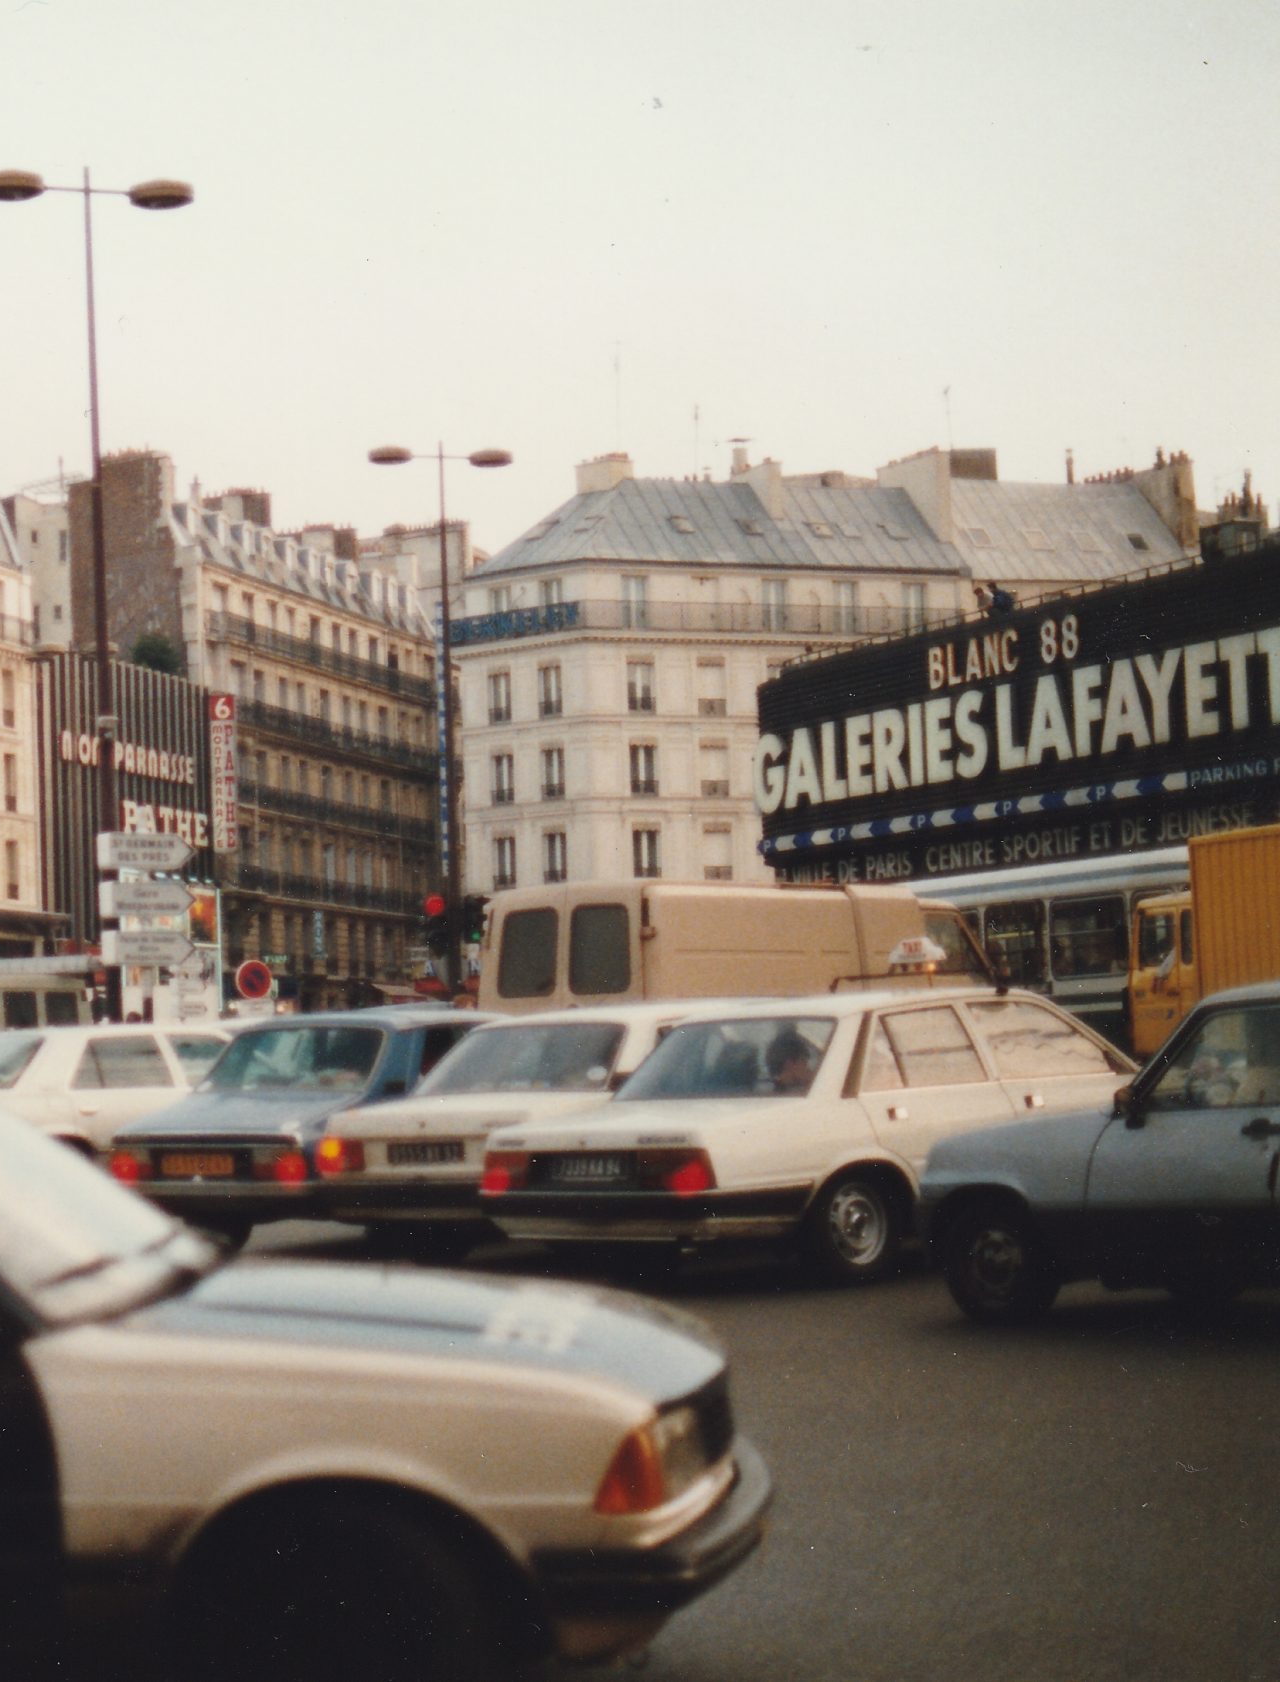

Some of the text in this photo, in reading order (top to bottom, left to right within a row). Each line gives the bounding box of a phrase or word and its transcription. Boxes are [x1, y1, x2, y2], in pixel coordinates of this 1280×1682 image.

[928, 614, 1080, 690] BLANC 88
[214, 697, 232, 719] 6
[754, 690, 989, 814] GALERIES
[1191, 760, 1268, 785] PARKING
[1096, 786, 1107, 800] P
[1003, 801, 1013, 815] P
[917, 814, 927, 828] P
[837, 827, 847, 841] P
[926, 803, 1251, 872] CENTRE SPORTIF ET DE JEUNESSE
[763, 841, 771, 852] P
[838, 859, 860, 885] DE
[866, 852, 913, 880] PARIS
